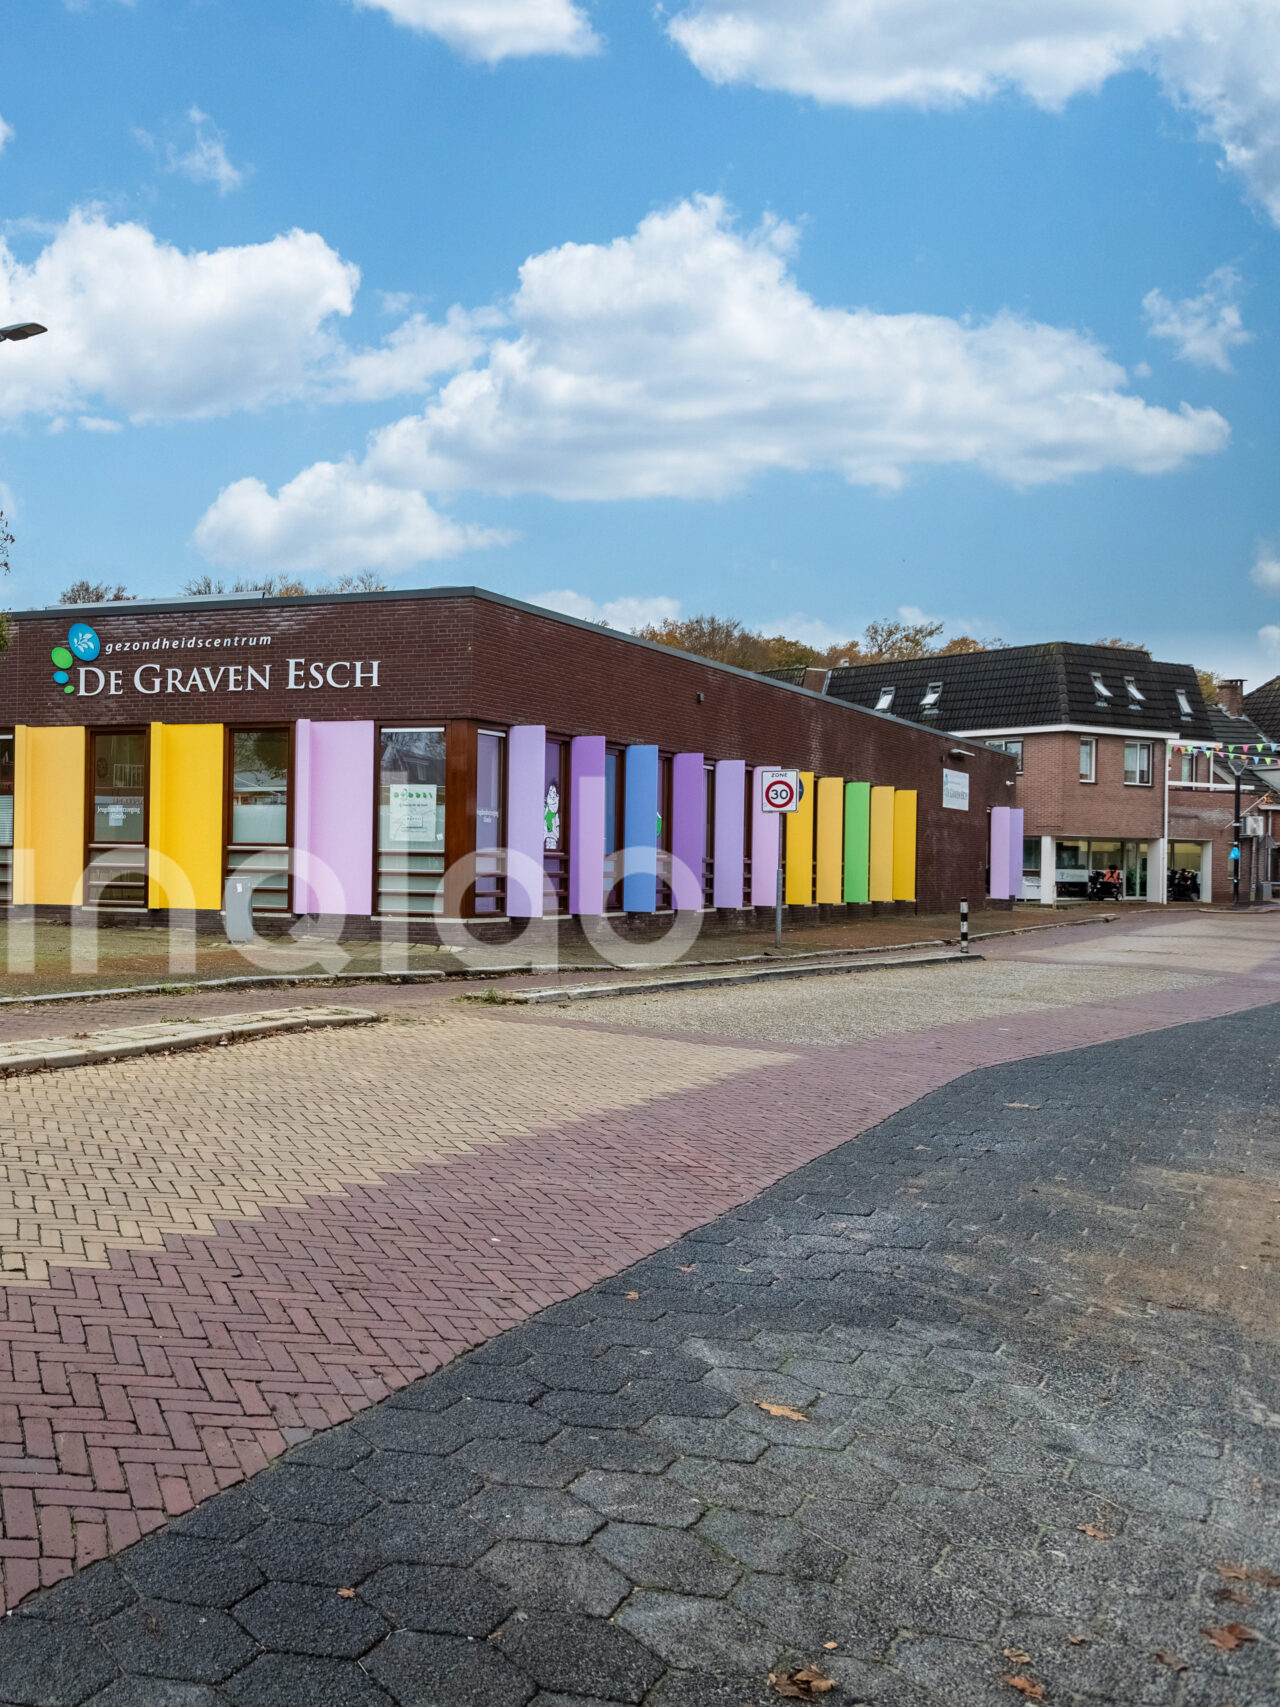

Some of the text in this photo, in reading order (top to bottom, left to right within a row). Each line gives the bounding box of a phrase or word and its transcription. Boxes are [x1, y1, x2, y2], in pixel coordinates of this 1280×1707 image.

[105, 635, 272, 655] gezondheidscentrum
[77, 658, 382, 697] DE GRAVEN ESCH
[771, 789, 788, 799] 30
